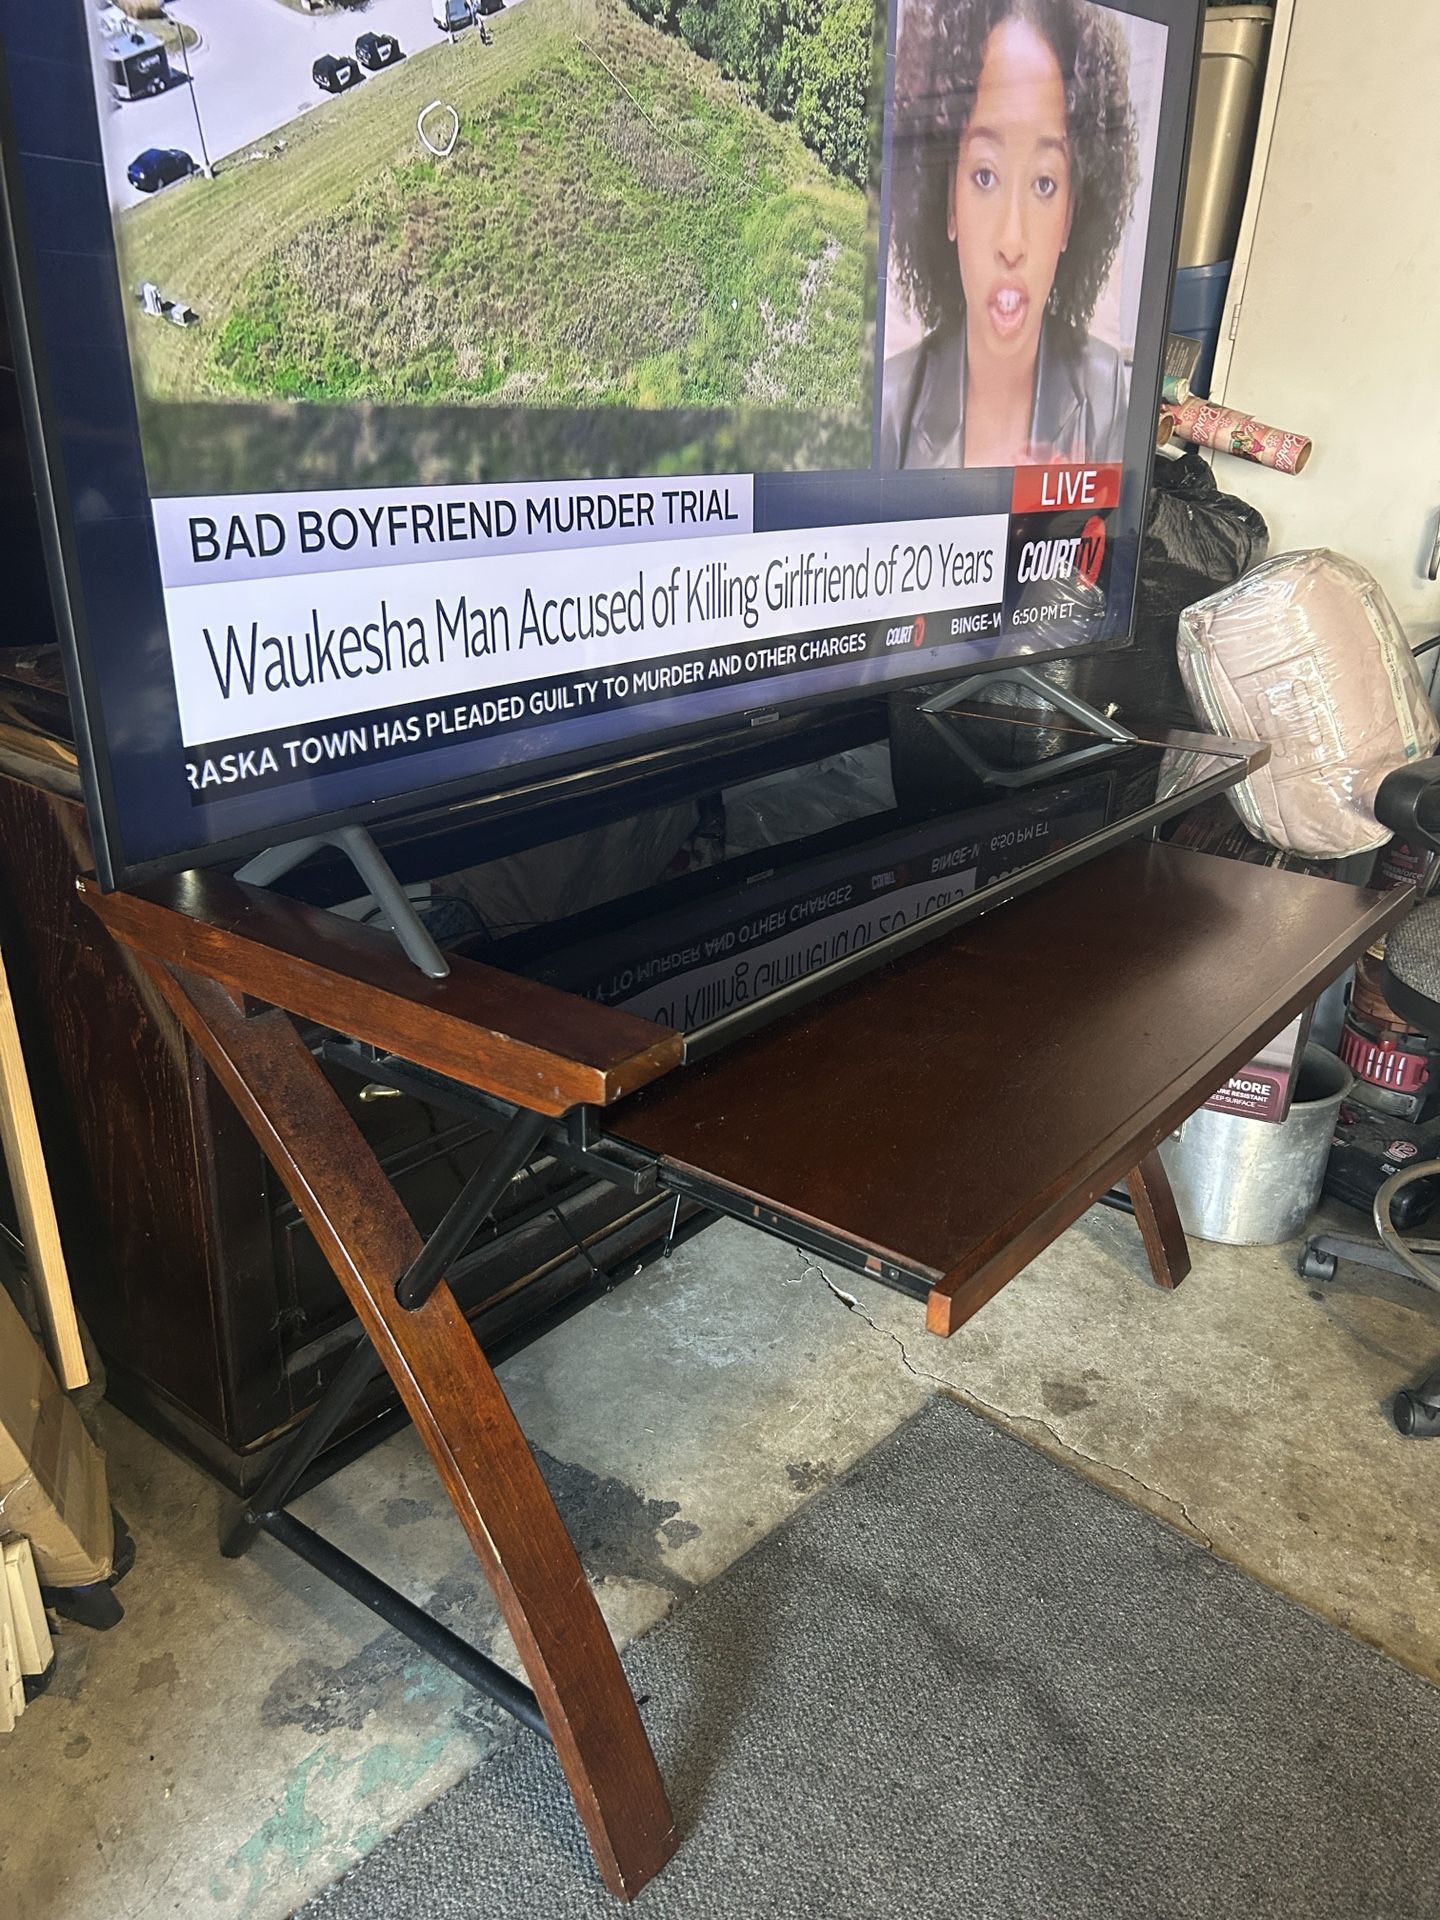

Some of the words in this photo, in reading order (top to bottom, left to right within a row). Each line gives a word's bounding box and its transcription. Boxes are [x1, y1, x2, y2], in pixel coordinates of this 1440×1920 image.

[1041, 471, 1097, 506] LIVE
[188, 513, 286, 563] BAD
[298, 500, 517, 553] BOYFRIEND
[526, 492, 655, 535] MURDER
[662, 488, 739, 524] TRIAL
[1017, 537, 1081, 583] COURT
[203, 601, 430, 699] Waukesha
[435, 596, 511, 663] Man
[519, 571, 644, 650] Accused
[651, 568, 681, 629] of
[686, 562, 760, 628] Killing
[765, 546, 868, 611] Girlfriend
[875, 544, 899, 595] of
[901, 545, 934, 592] 20
[938, 542, 994, 588] Years
[1012, 607, 1039, 625] 6:50
[1040, 604, 1058, 621] PM
[1059, 603, 1076, 618] ET
[885, 625, 914, 646] COURT
[283, 727, 366, 768] TOWN
[373, 717, 421, 748] HAS
[426, 696, 525, 737] PLEADED
[529, 680, 599, 714] GUILTY
[602, 677, 628, 701] TO
[632, 662, 704, 694] MURDER
[708, 655, 741, 679] AND
[745, 645, 796, 673] OTHER
[800, 633, 866, 662] CHARGES
[1228, 1078, 1272, 1096] MORE
[1231, 1090, 1269, 1103] RESISTANT
[1225, 1096, 1257, 1108] SURFACE
